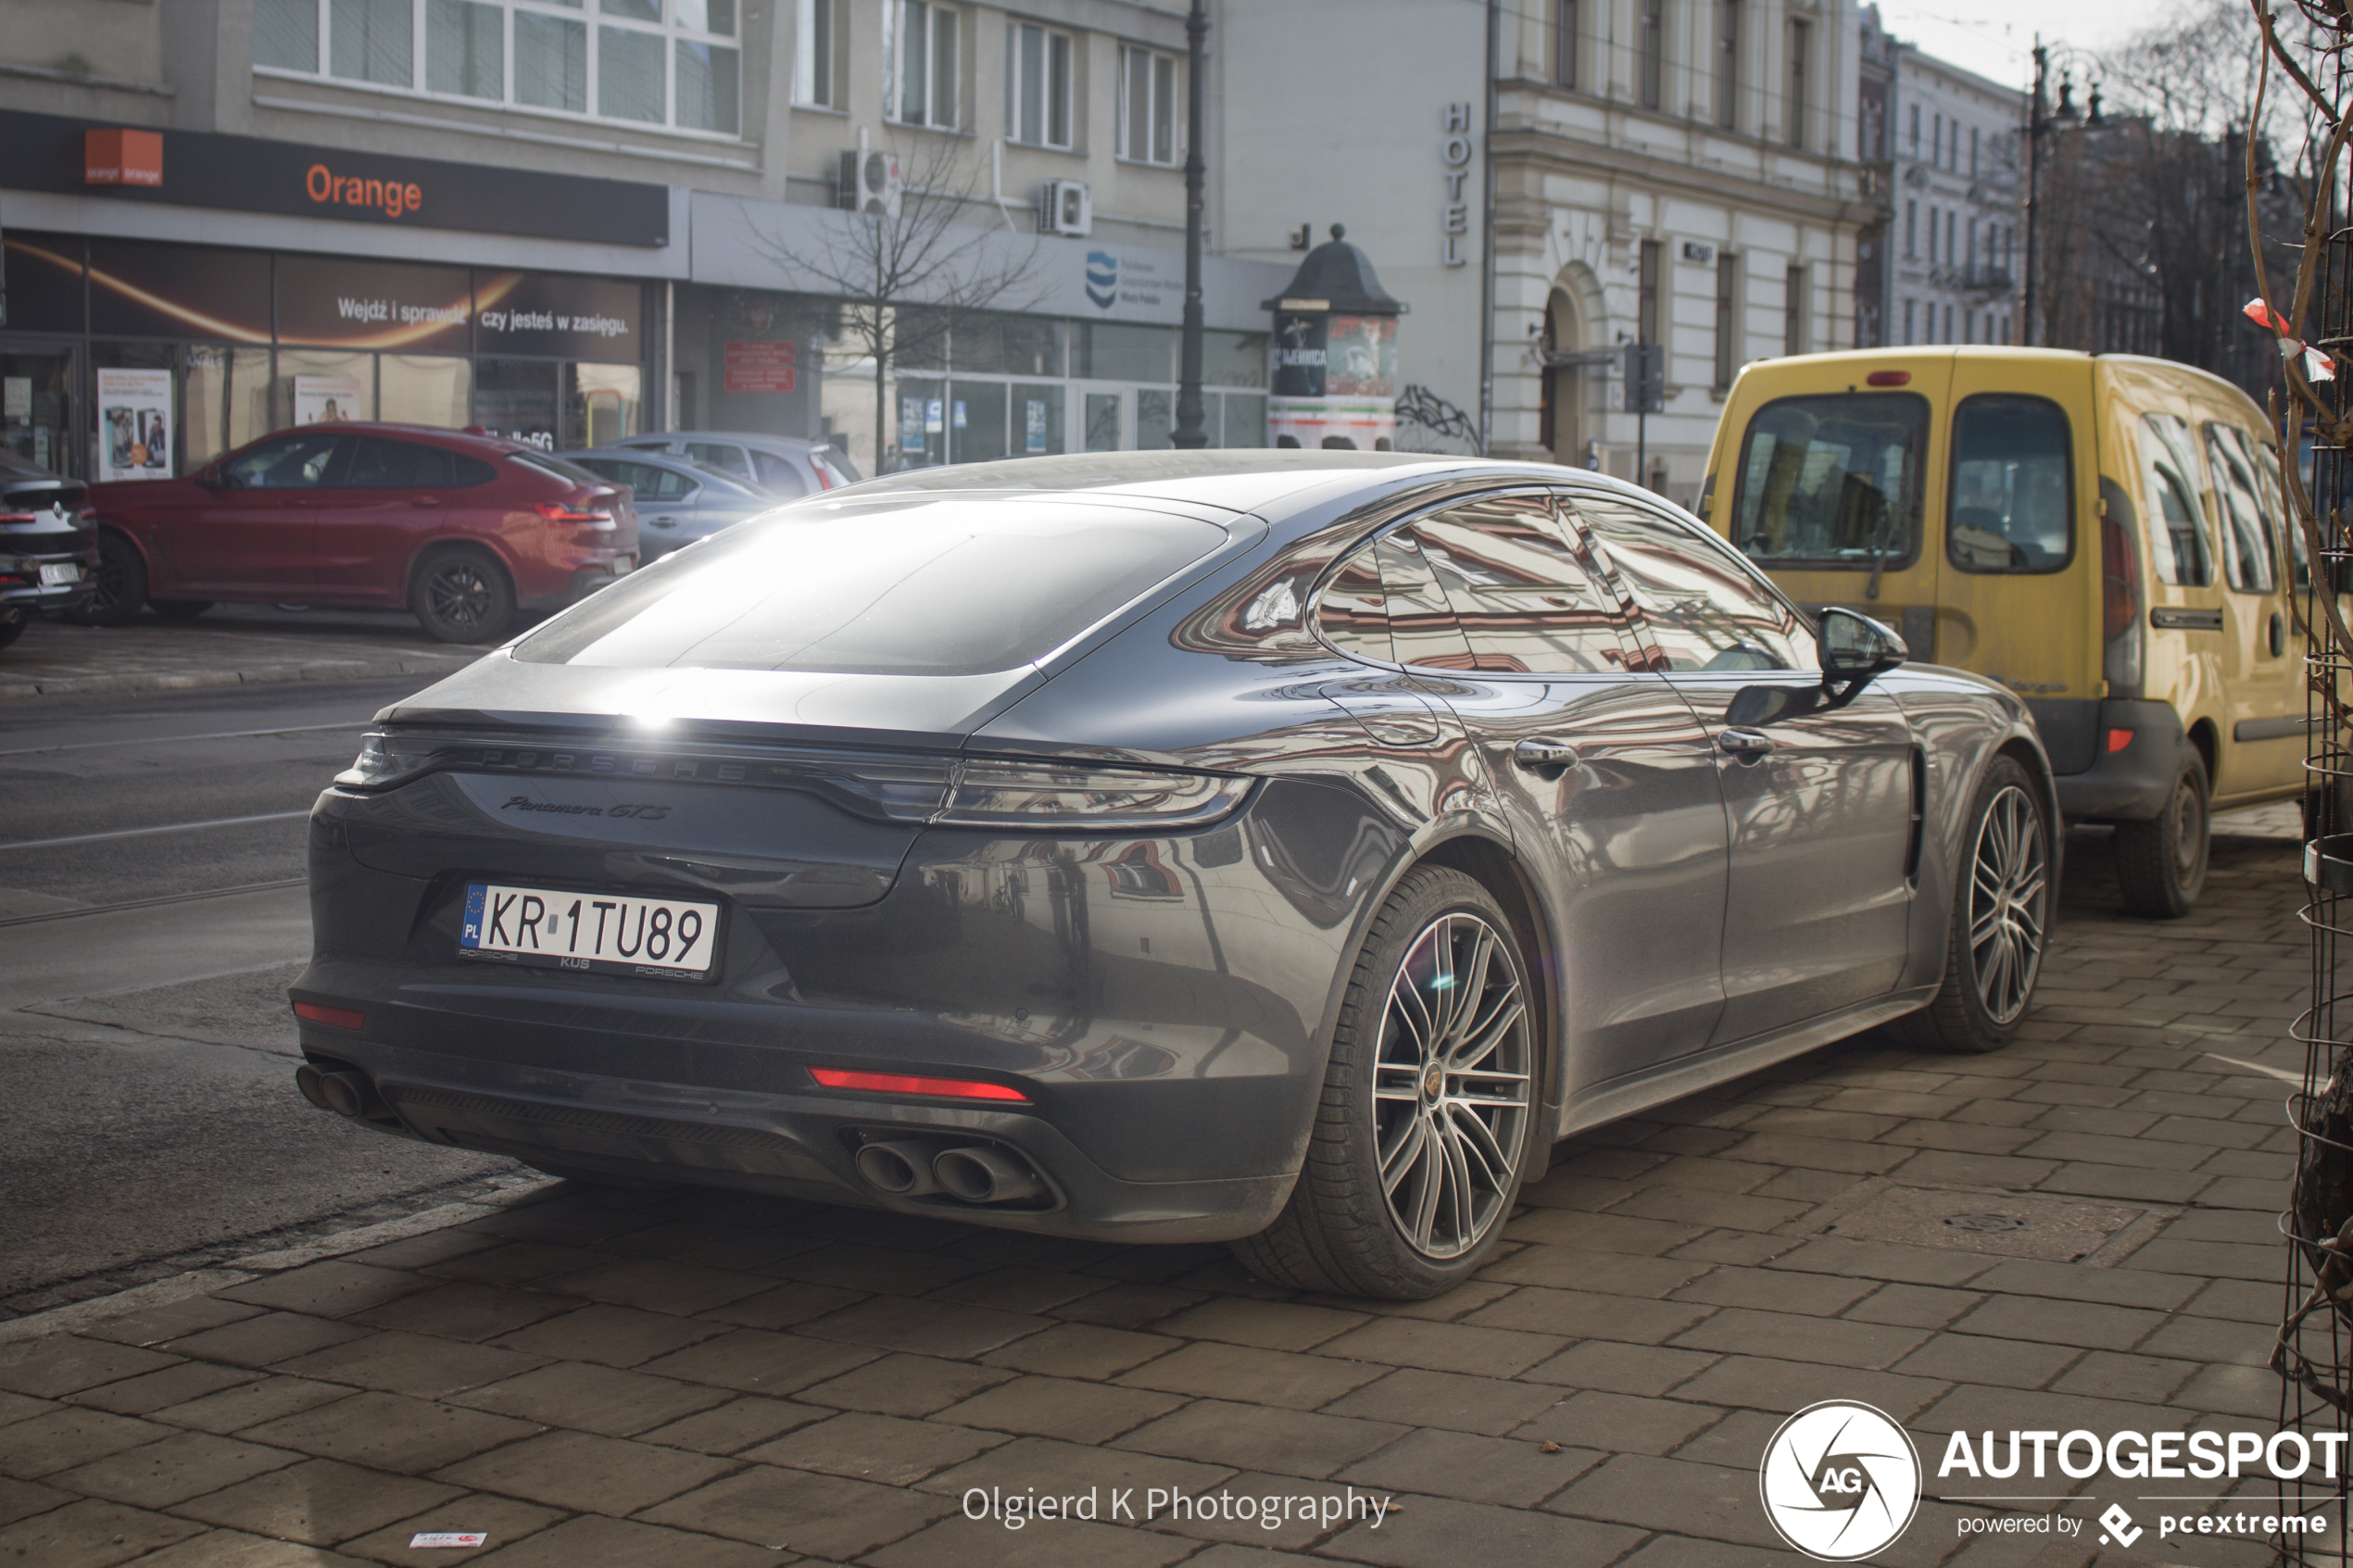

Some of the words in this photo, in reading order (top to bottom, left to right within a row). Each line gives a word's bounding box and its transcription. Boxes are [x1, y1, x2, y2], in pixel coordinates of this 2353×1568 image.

[124, 168, 159, 182] orange
[307, 164, 422, 218] Orange
[1442, 102, 1471, 269] HOTEL
[337, 297, 388, 323] Wejdź
[392, 300, 396, 320] i
[400, 303, 467, 325] sprawdź
[481, 311, 508, 332] czy
[509, 308, 553, 332] jesteś
[557, 314, 571, 331] w
[573, 314, 629, 337] zasięgu.
[483, 749, 747, 781] PORSCHE
[500, 795, 604, 817] Panamera
[608, 803, 672, 821] GTS
[464, 923, 479, 939] PL
[488, 892, 546, 948] KR
[567, 899, 702, 963] 1TU89
[459, 948, 518, 961] PORSCHE
[560, 957, 590, 970] KUS
[635, 966, 703, 980] PORSCHE
